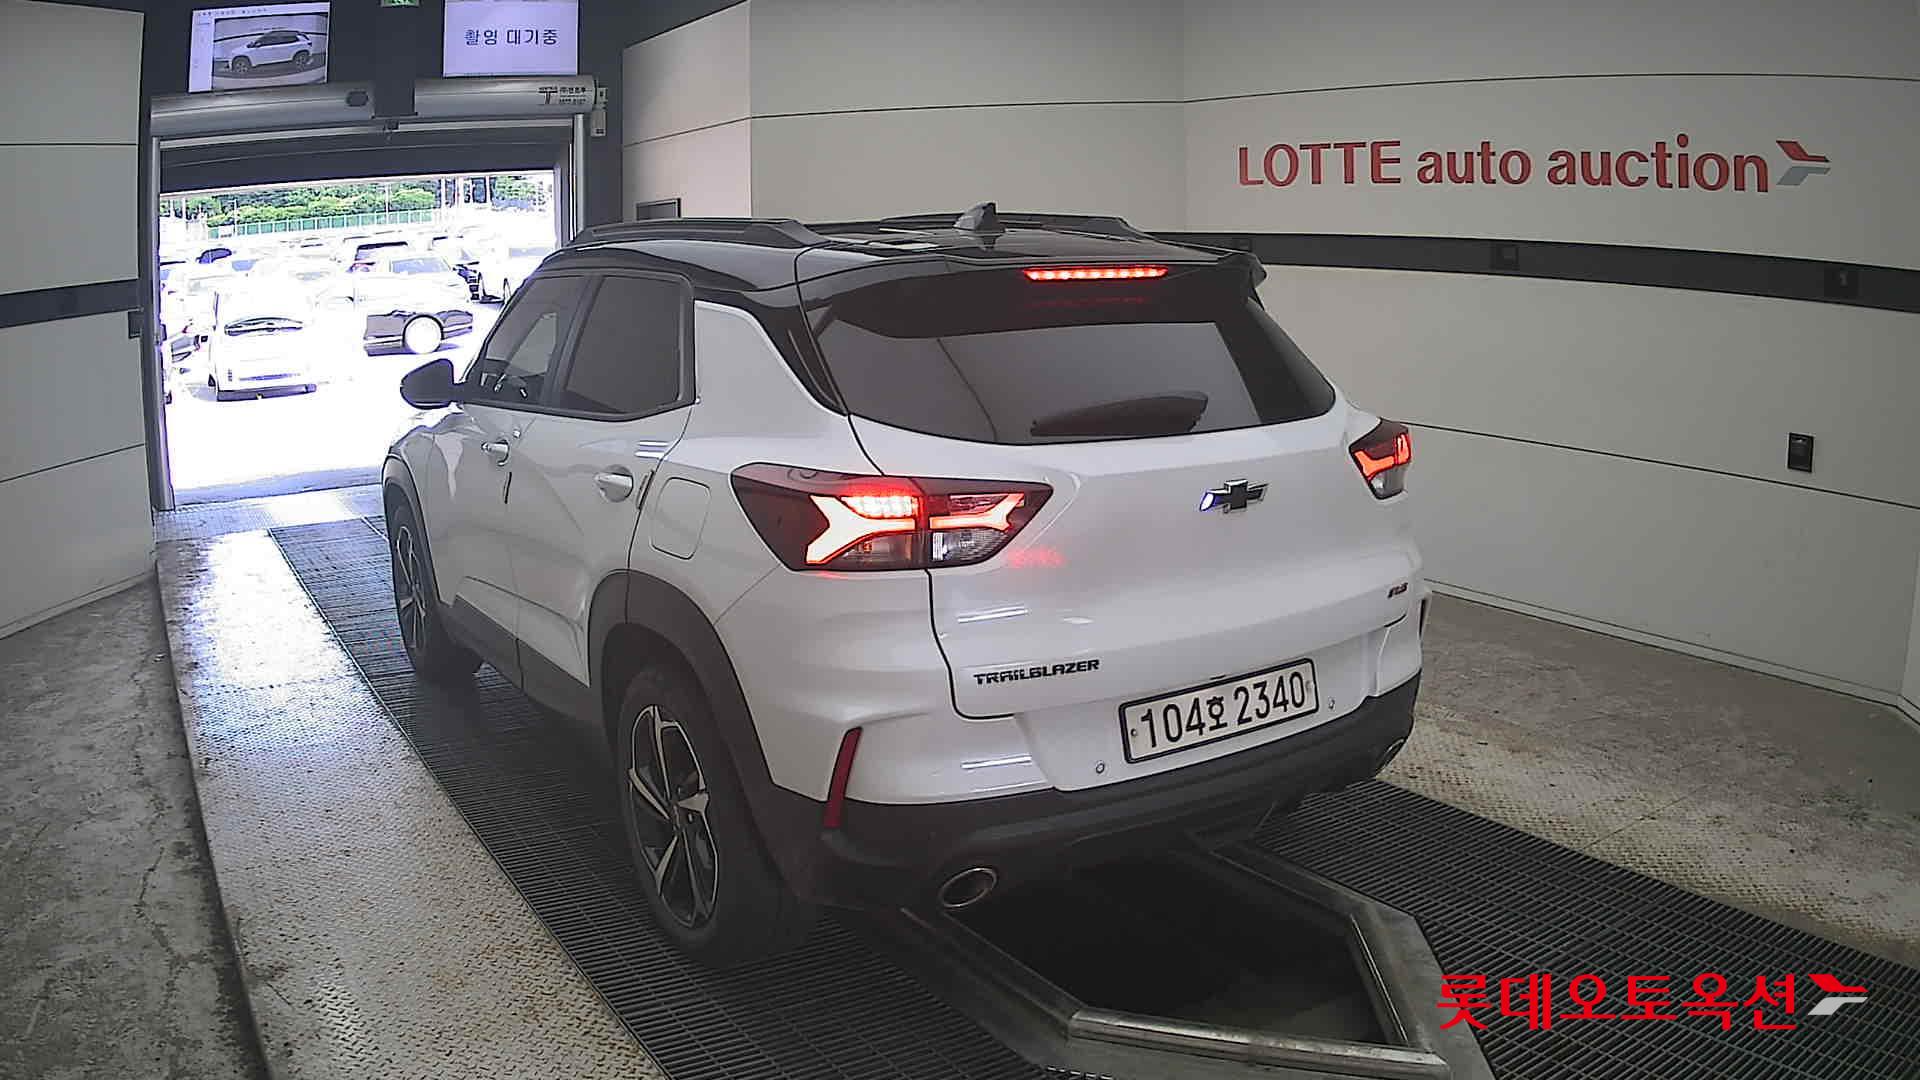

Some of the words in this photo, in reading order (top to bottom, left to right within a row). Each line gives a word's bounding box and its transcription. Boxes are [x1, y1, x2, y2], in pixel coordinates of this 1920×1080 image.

[506, 29, 558, 46] 대기중
[1239, 140, 1401, 187] LOTTE
[1416, 141, 1532, 185] auto
[1547, 133, 1769, 193] auction
[973, 659, 1100, 685] TRAILBLAZER
[1233, 671, 1306, 726] 2340
